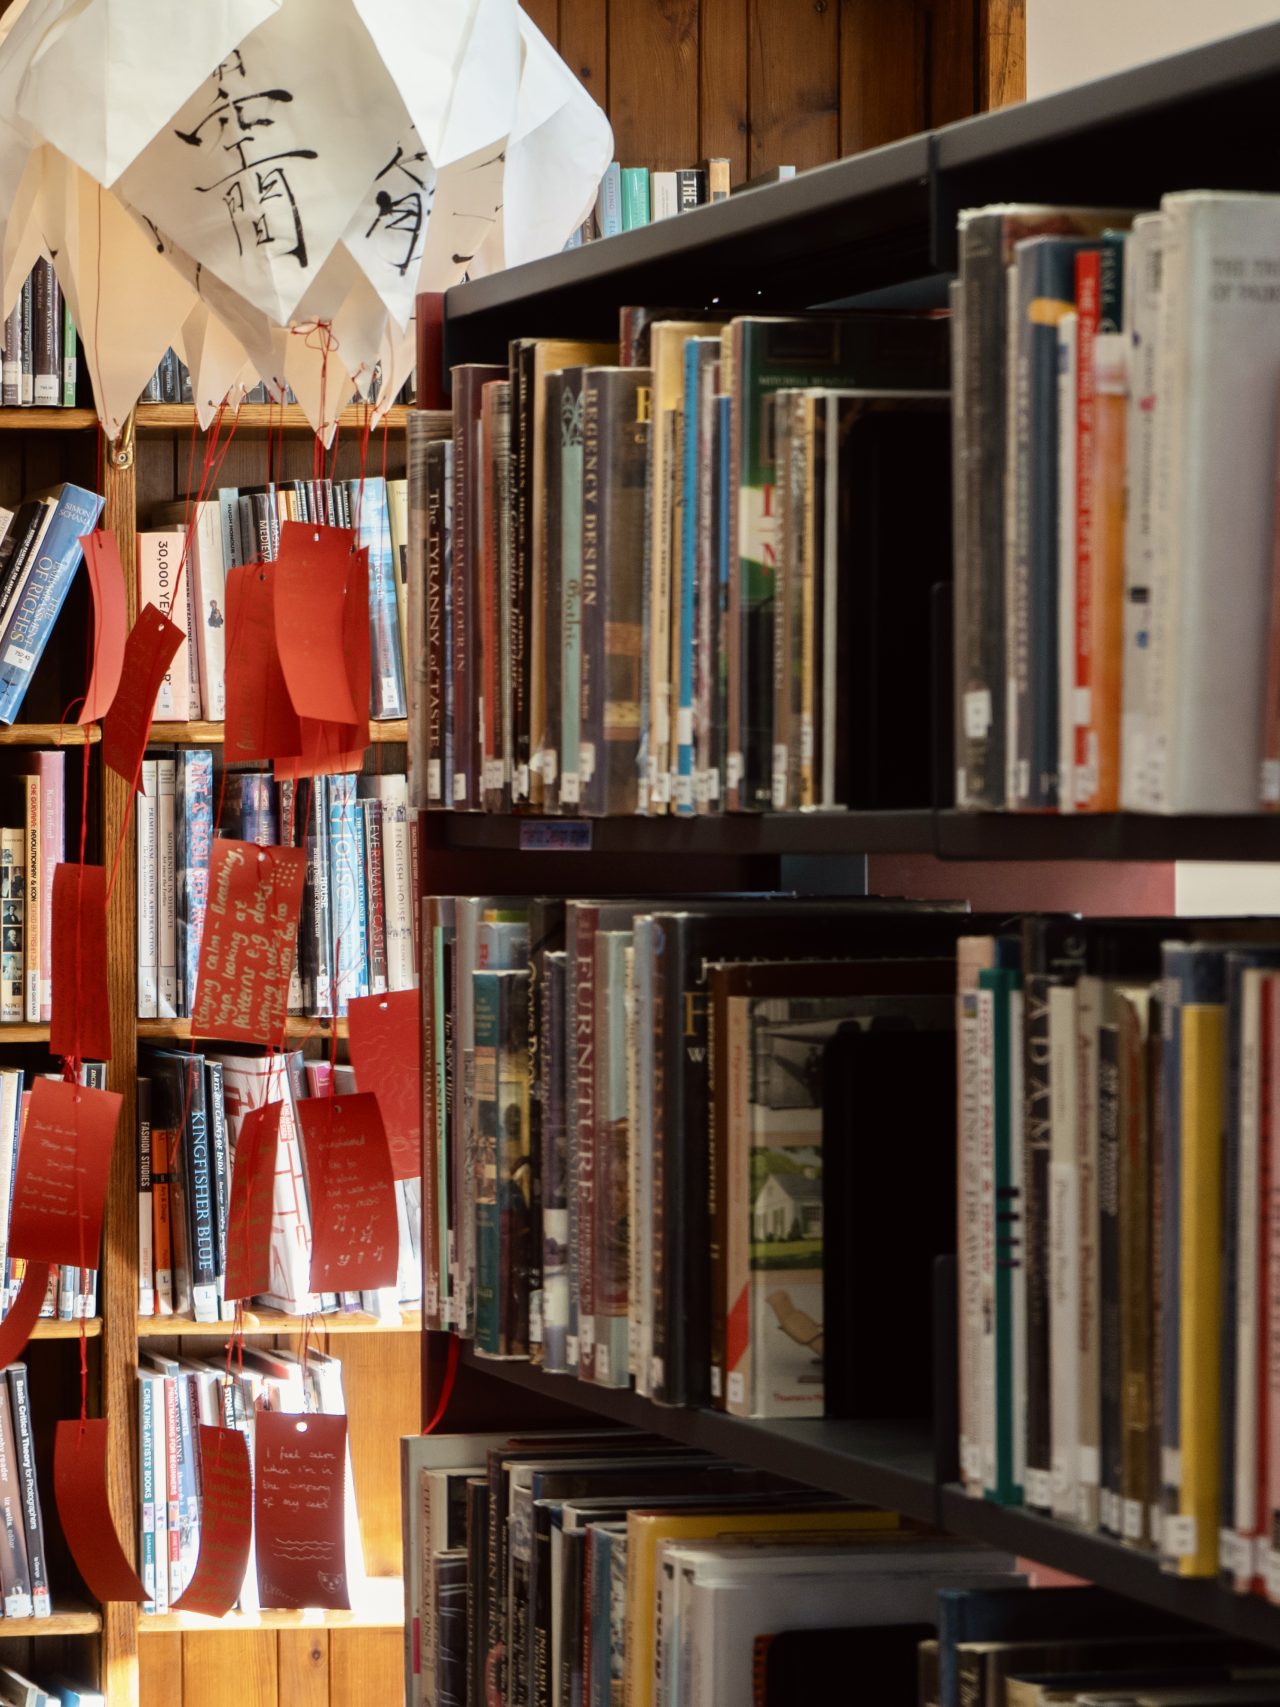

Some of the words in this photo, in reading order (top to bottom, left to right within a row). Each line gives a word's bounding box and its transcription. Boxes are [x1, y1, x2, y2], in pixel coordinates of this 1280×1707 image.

[682, 178, 698, 205] THE
[583, 388, 599, 504] REGENCY
[429, 489, 440, 524] The
[36, 556, 53, 581] OF
[583, 513, 598, 606] DESIGN
[428, 532, 441, 646] TYRANNY
[10, 582, 43, 641] RICHES
[428, 654, 441, 673] of
[429, 679, 440, 748] TASTE
[576, 955, 593, 1203] FURNITURE
[140, 1121, 150, 1153] FASHION
[140, 1156, 150, 1187] STUDIES
[191, 1111, 208, 1219] KINGFISHER
[198, 1227, 212, 1270] BLUE
[143, 1388, 151, 1430] CREATING
[169, 1387, 177, 1436] PRINTMAKING
[143, 1432, 151, 1469] ARTISTS'
[169, 1437, 177, 1452] FOR
[144, 1470, 152, 1499] BOOKS
[169, 1454, 177, 1495] BEGINNERS
